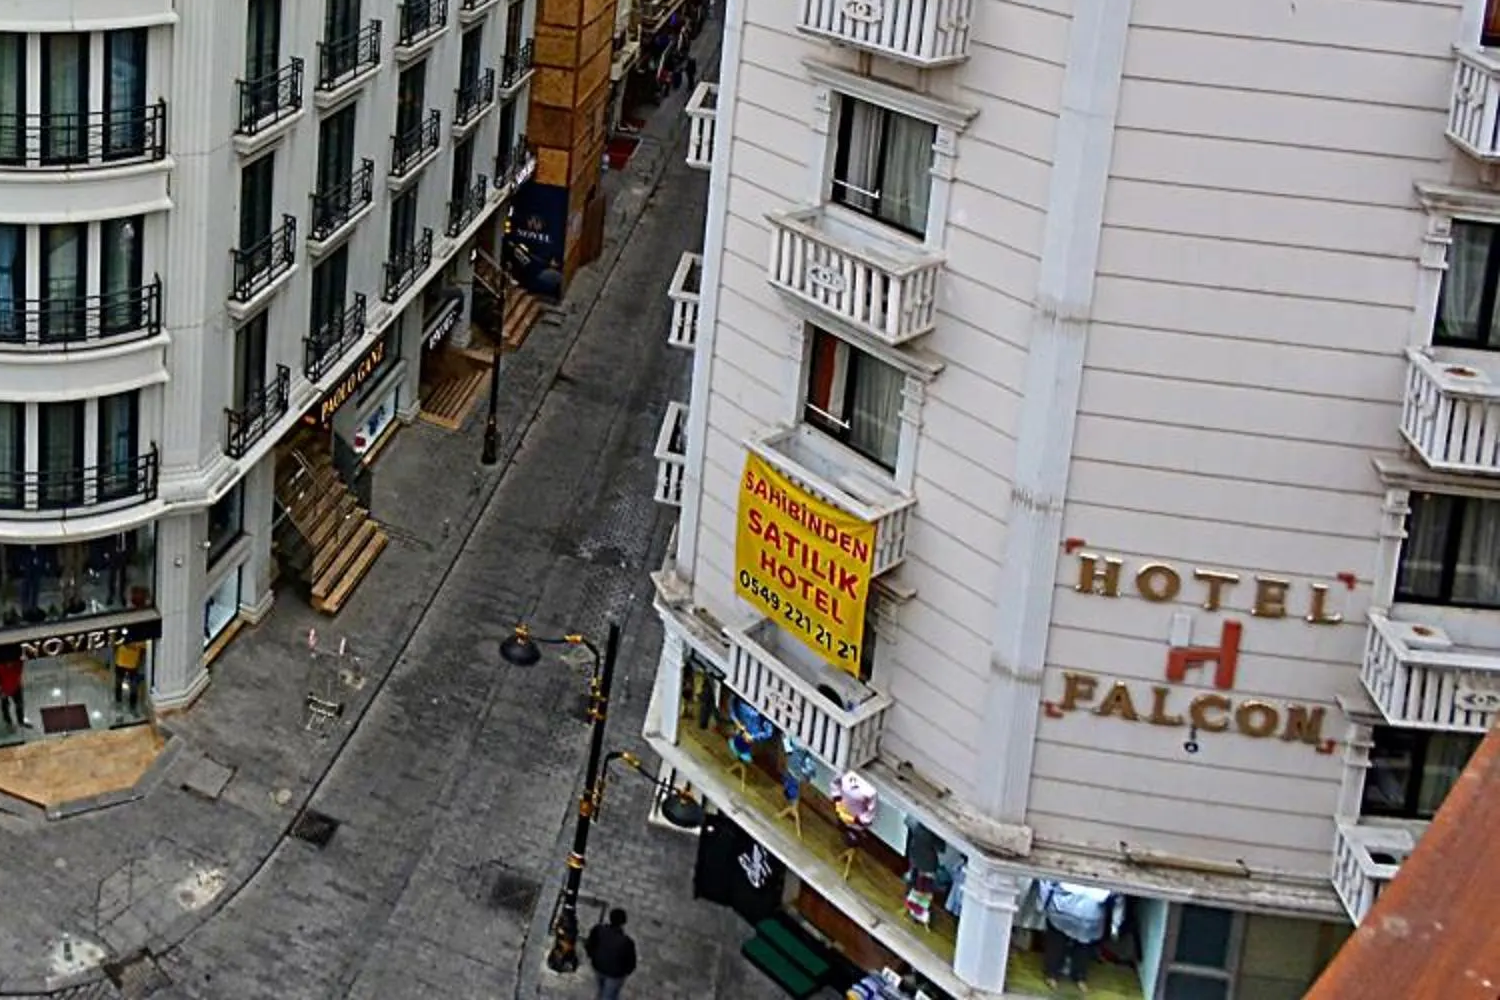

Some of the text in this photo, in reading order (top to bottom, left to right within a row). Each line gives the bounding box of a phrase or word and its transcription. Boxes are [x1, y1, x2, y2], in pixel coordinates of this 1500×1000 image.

[745, 471, 869, 564] SAHİBİNDEN
[747, 508, 859, 600] SATILIK
[739, 569, 859, 662] 0549 221 21 21
[760, 550, 844, 625] HOTEL
[1074, 552, 1344, 624] HOTEL
[20, 629, 126, 661] NOVEL
[1060, 671, 1327, 744] FALCON
